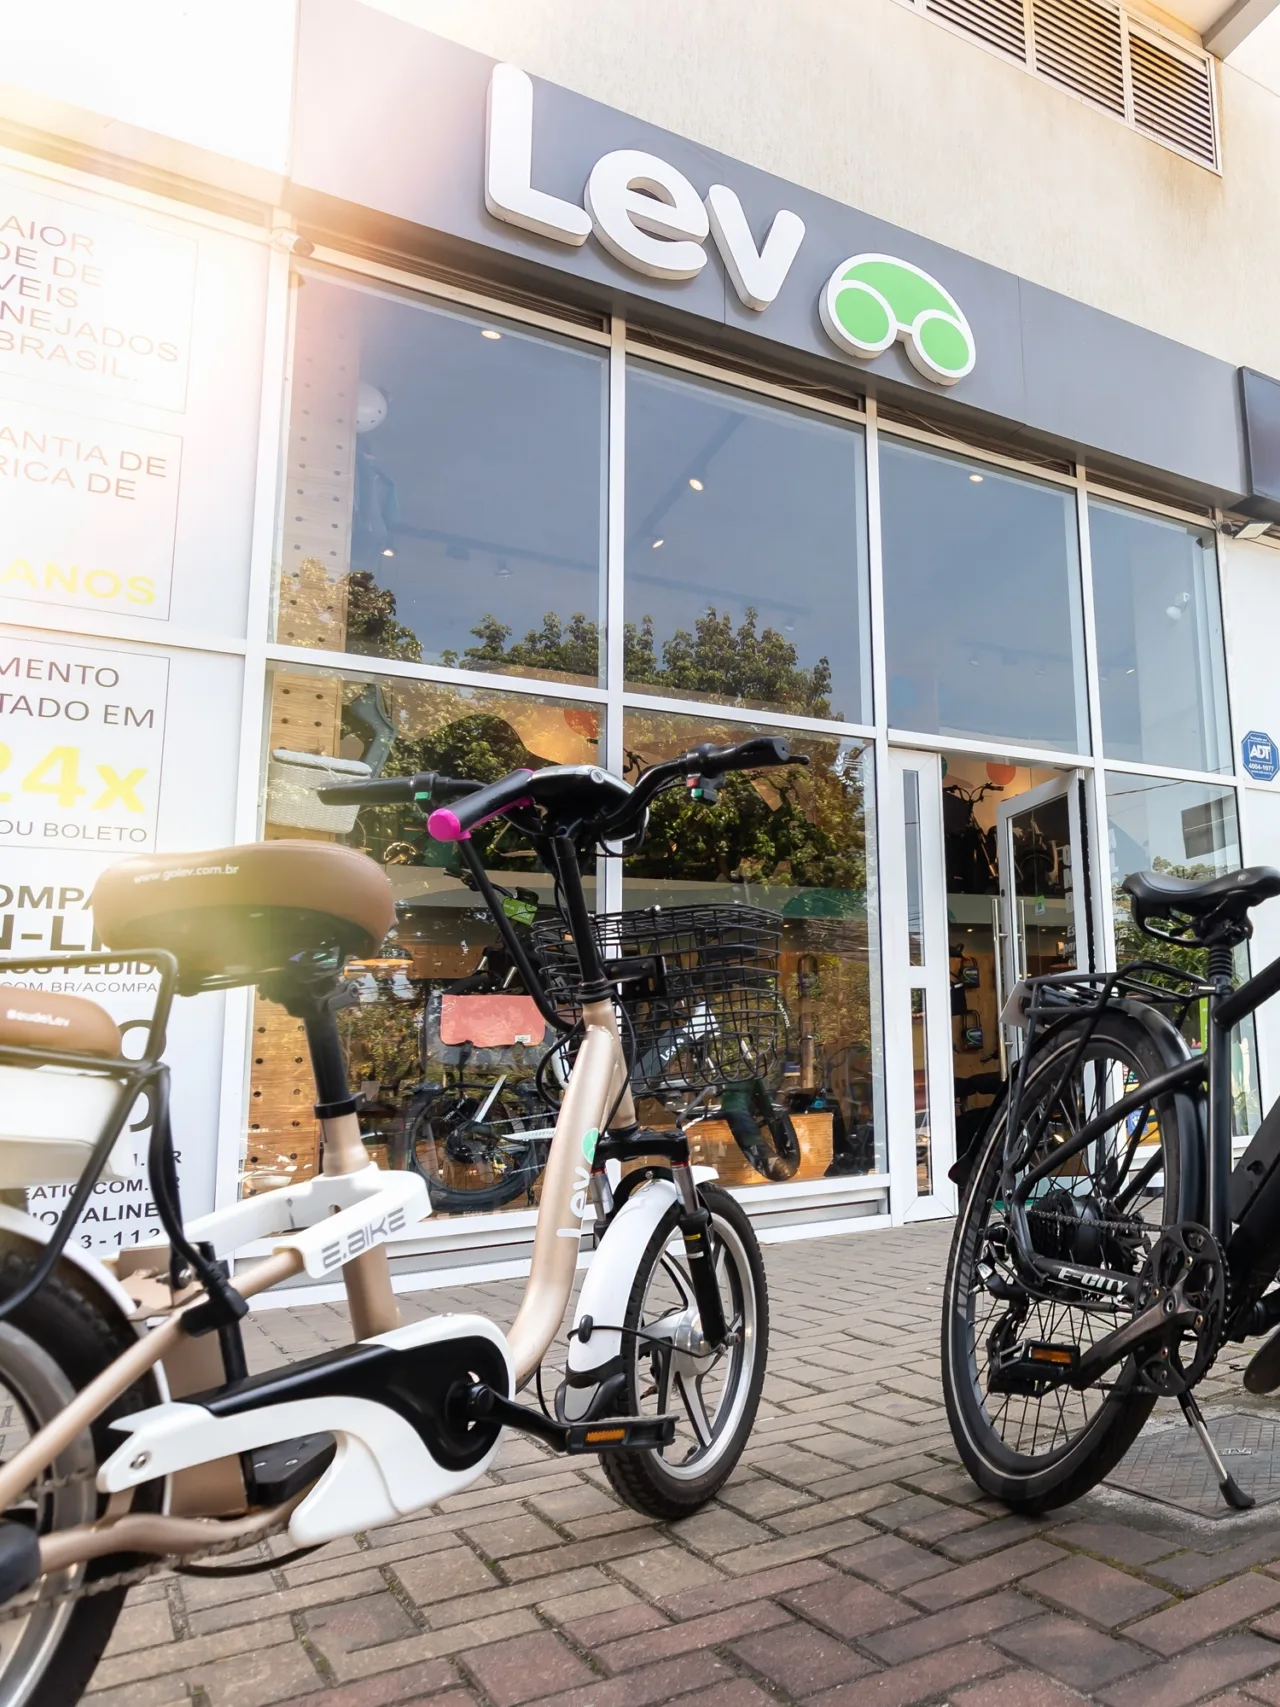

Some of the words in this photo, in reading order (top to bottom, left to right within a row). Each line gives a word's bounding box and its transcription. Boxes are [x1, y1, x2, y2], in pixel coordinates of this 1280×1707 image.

[485, 61, 806, 311] Lev
[53, 256, 103, 287] DE
[120, 450, 166, 478] DE
[88, 473, 136, 500] DE
[103, 704, 155, 729] EM
[1250, 744, 1271, 760] ADT
[0, 742, 148, 813] 4x
[43, 822, 147, 843] BOLETO
[1057, 1266, 1129, 1293] E-CITY
